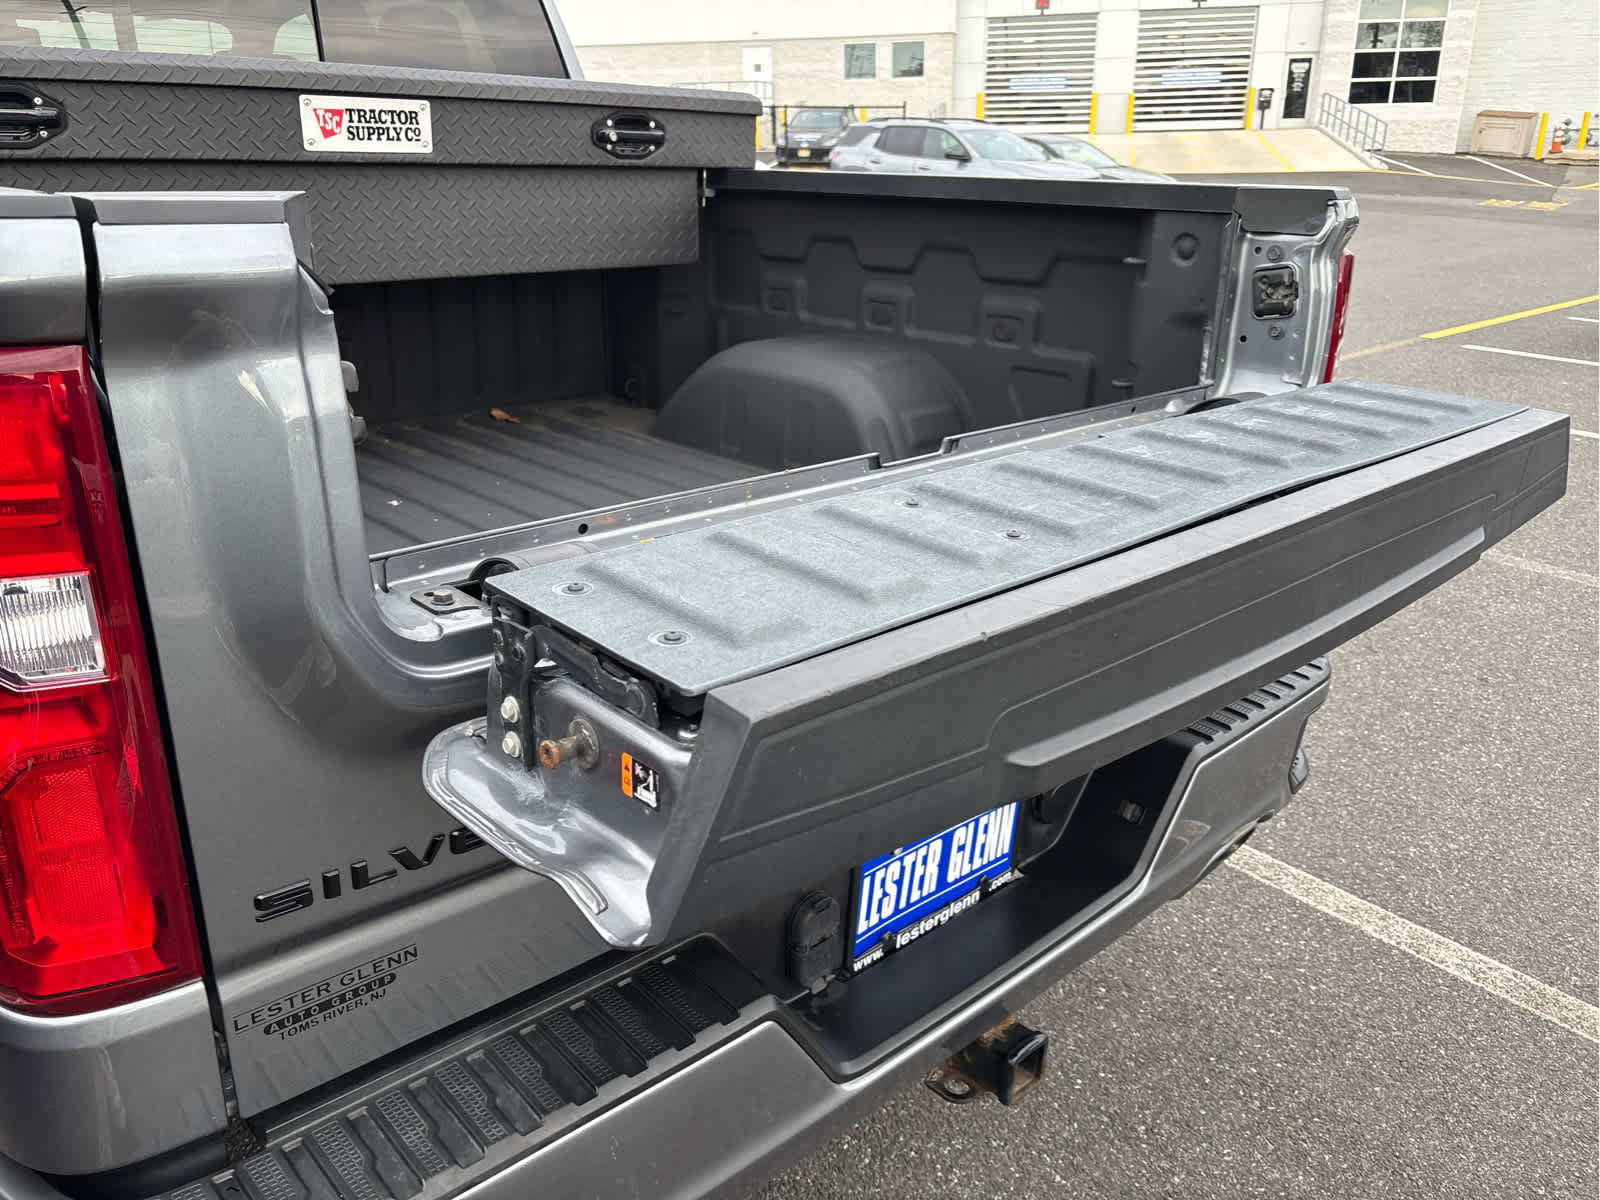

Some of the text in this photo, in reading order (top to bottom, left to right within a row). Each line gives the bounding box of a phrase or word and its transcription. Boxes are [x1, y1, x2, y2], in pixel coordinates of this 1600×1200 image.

[315, 108, 341, 134] TSC
[345, 108, 420, 126] TRACTOR
[347, 125, 403, 142] SUPPLY
[856, 802, 1017, 935] LESTER GLENN
[853, 871, 1012, 972] www. lesterglenn .com
[233, 946, 418, 1032] LESTER GLENN
[269, 974, 391, 1034] AUTO GROUP
[280, 988, 386, 1040] TOMS RIVER, NJ
